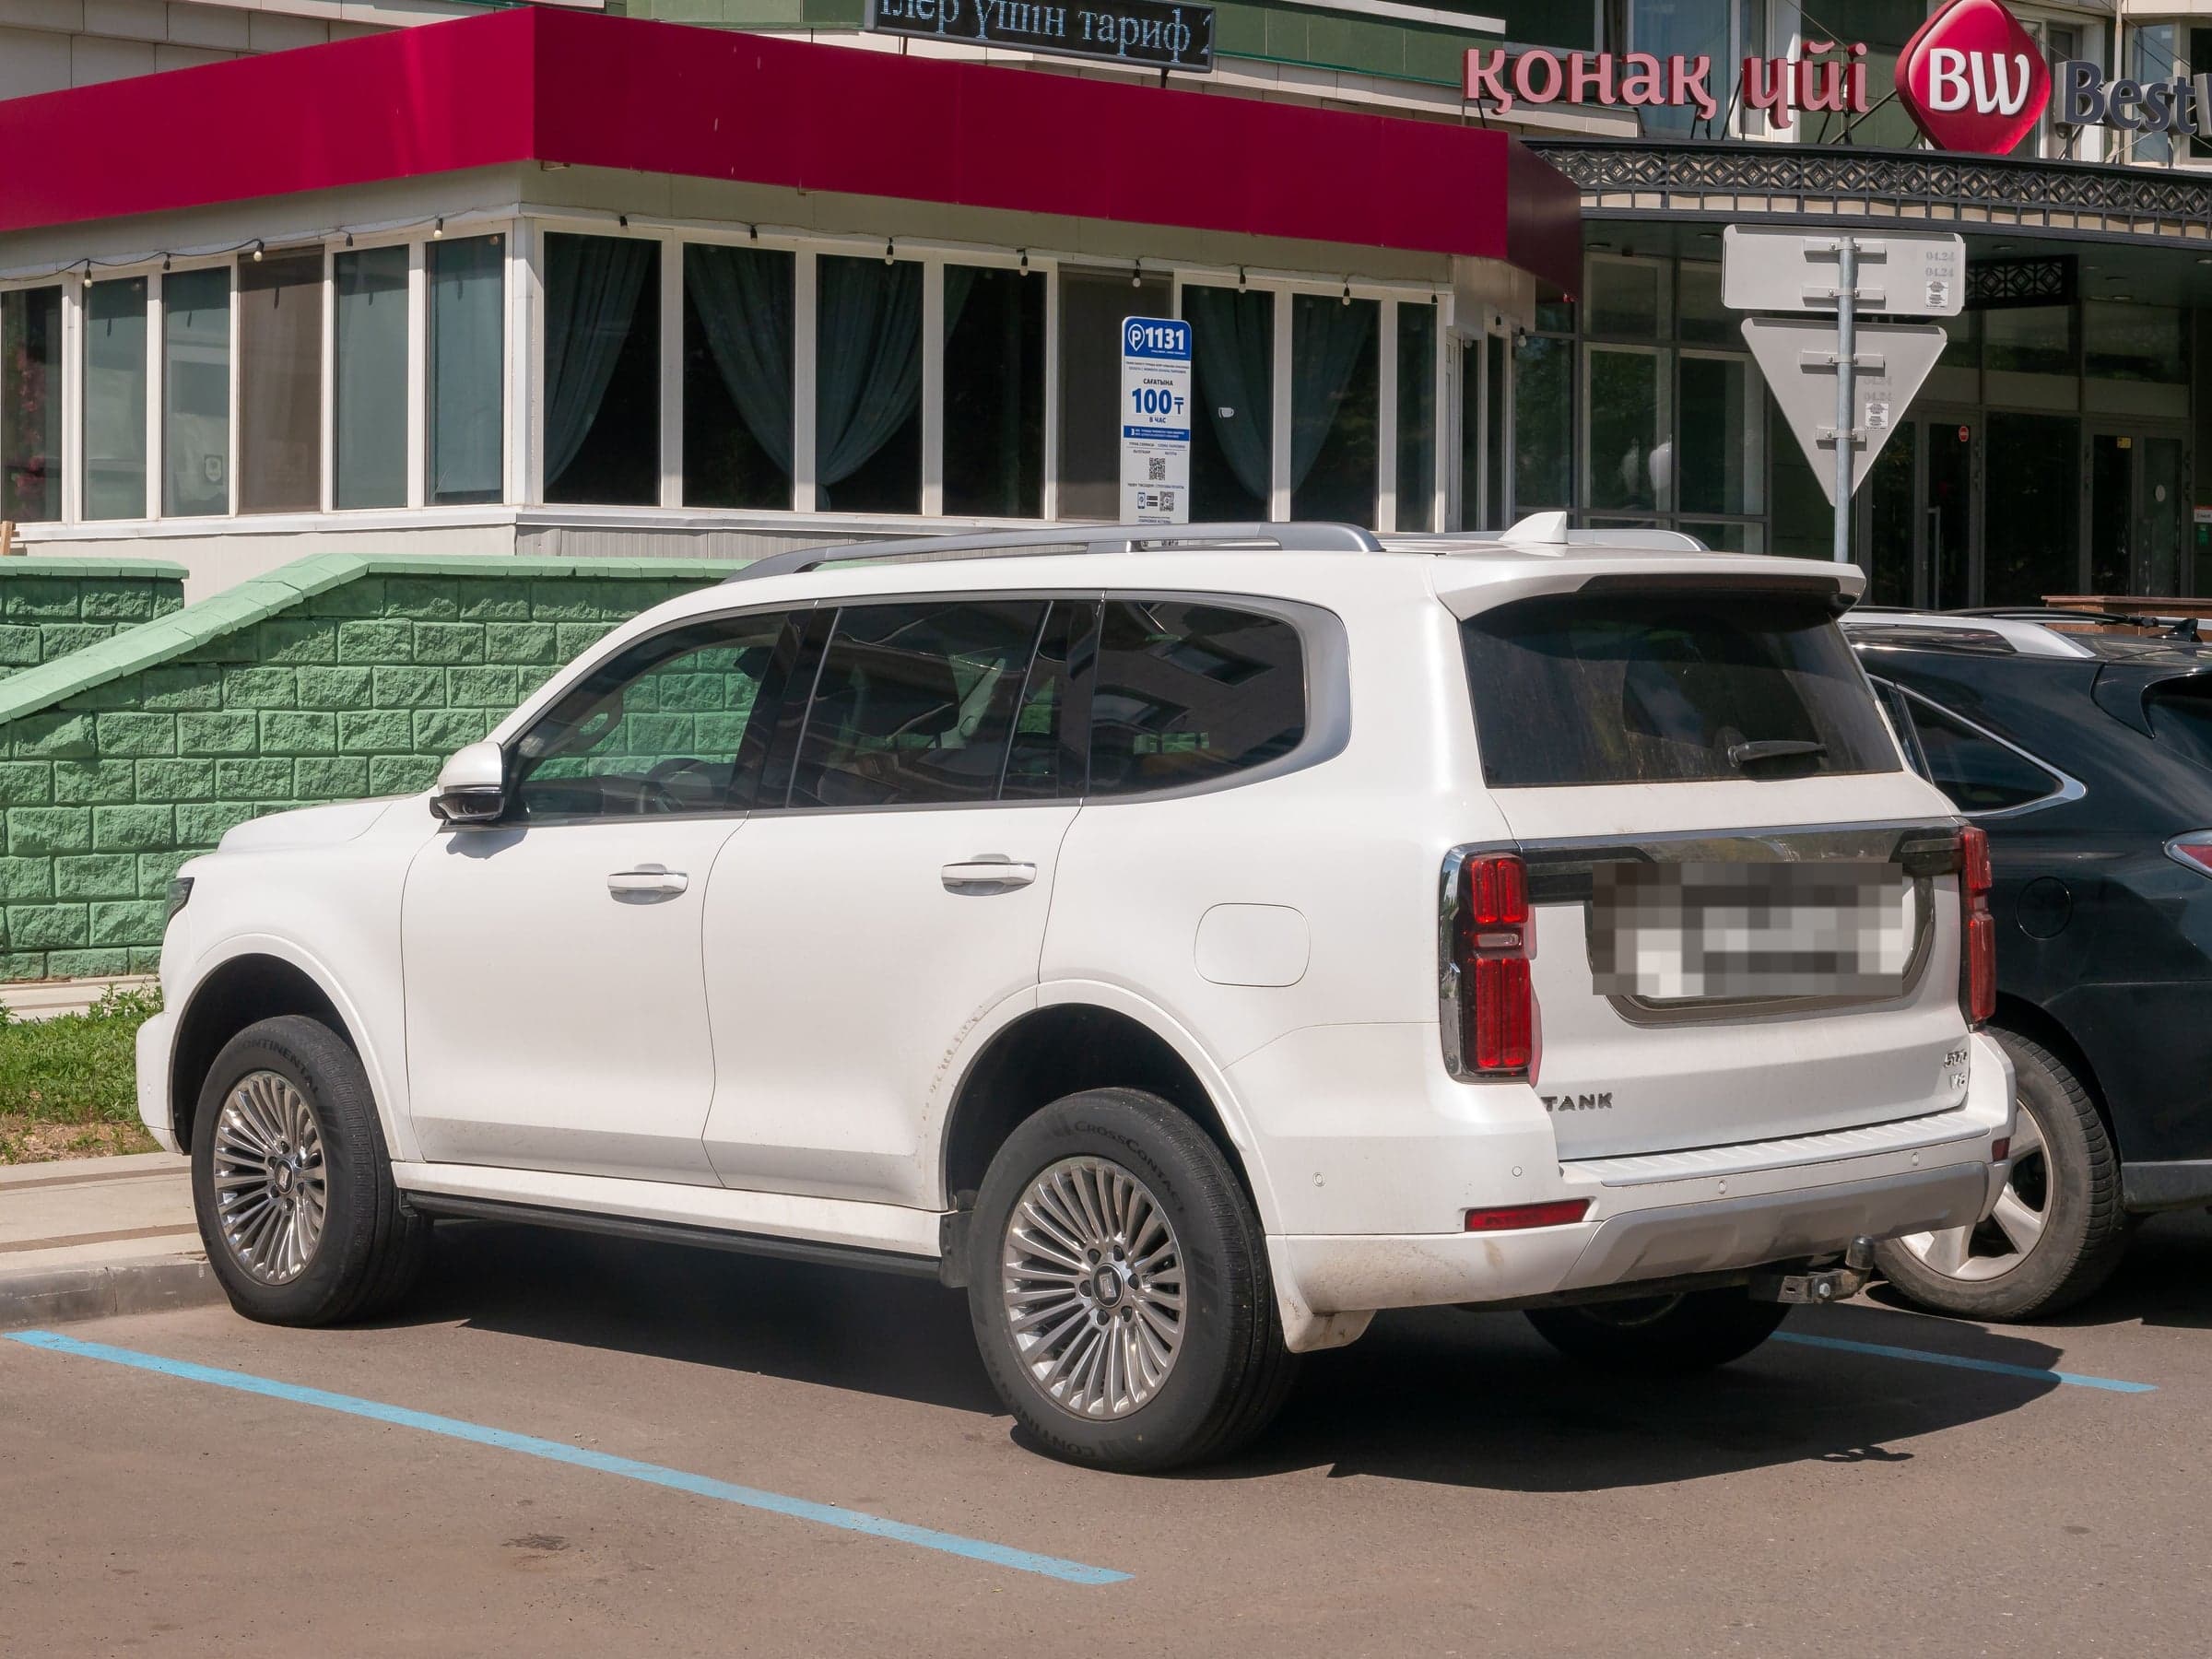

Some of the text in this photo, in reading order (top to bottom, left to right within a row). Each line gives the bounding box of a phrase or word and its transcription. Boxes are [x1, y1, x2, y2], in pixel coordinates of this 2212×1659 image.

[1077, 7, 1191, 64] тариф
[1460, 47, 1718, 122] қонақ
[1929, 47, 2030, 116] BW
[2056, 60, 2198, 135] Best
[1145, 326, 1184, 350] 1131
[1539, 1091, 1613, 1112] TANK
